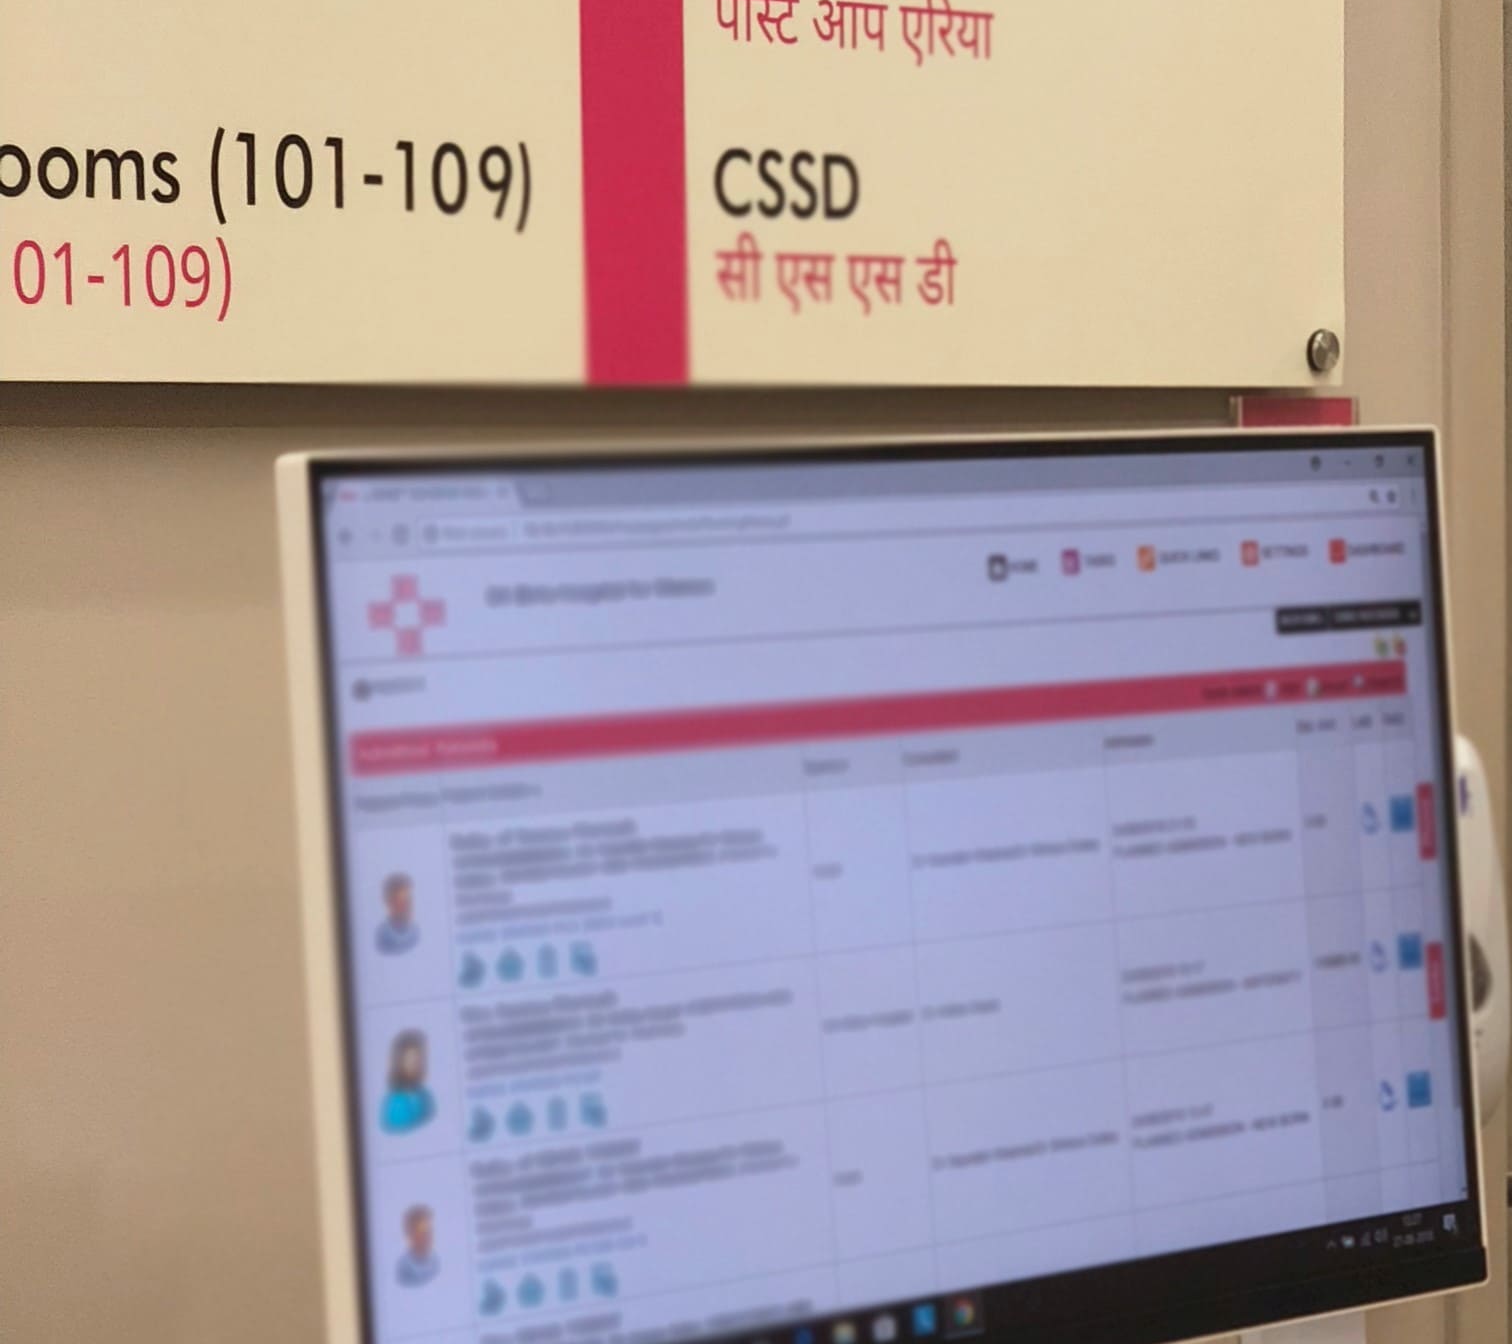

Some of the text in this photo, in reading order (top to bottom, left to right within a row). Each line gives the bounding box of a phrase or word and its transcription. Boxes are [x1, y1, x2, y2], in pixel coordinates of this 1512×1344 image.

[0, 126, 532, 234] ooms (101-109)
[713, 147, 861, 220] CSSD
[715, 231, 763, 301] सी
[916, 238, 958, 306] डी
